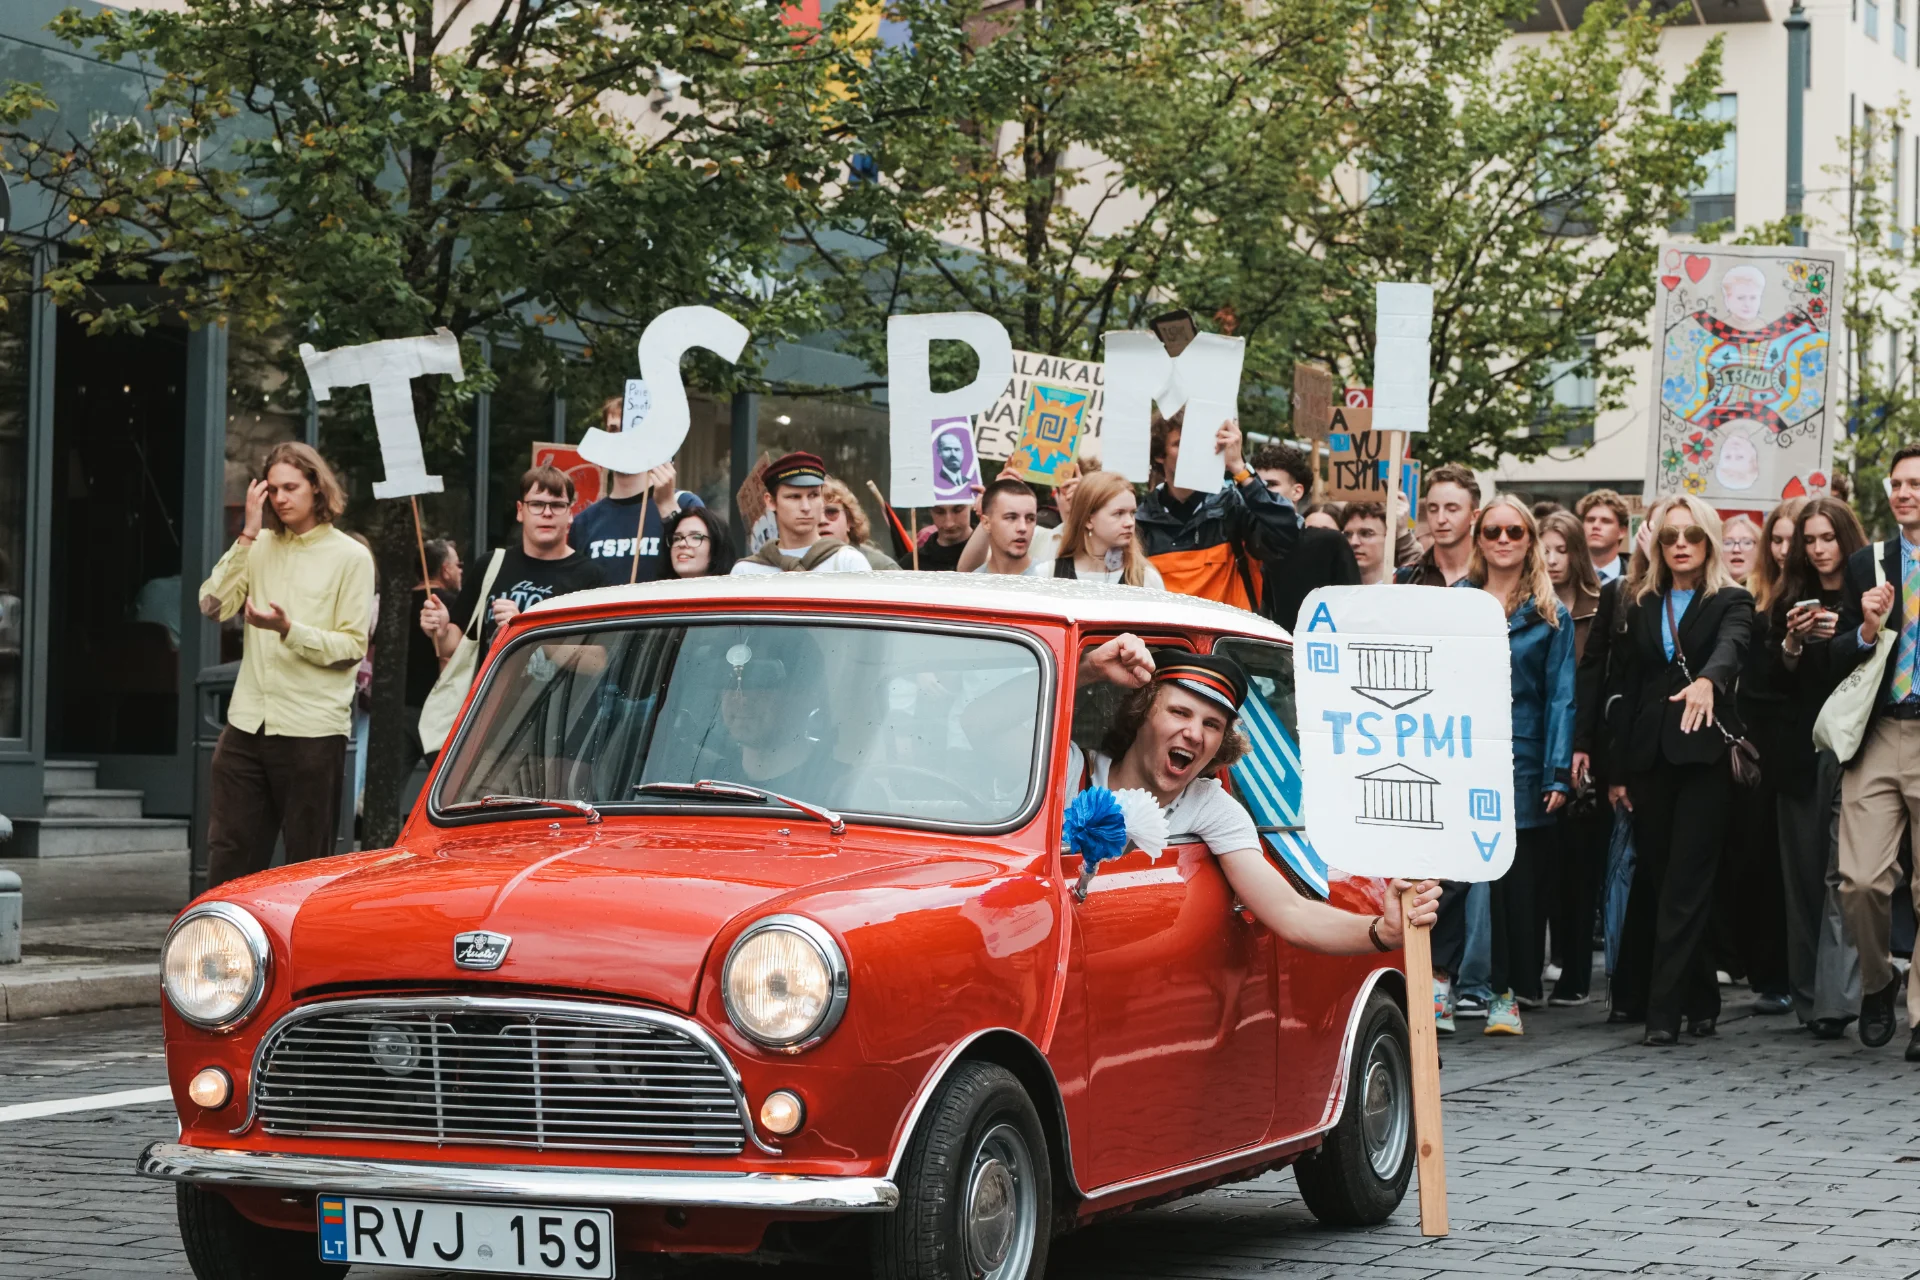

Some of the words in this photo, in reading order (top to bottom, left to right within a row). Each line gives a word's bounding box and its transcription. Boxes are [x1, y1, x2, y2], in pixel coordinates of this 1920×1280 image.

[299, 326, 465, 500] T
[577, 305, 750, 475] S
[887, 311, 1013, 508] P
[1100, 330, 1246, 494] M
[1329, 408, 1349, 431] A
[589, 537, 660, 559] TSPMI
[1307, 602, 1337, 632] A
[1323, 710, 1473, 759] TSPMI
[1471, 831, 1502, 863] A
[458, 943, 499, 961] Austin
[324, 1240, 344, 1255] LT
[353, 1205, 464, 1262] RVJ
[510, 1215, 601, 1270] 159
